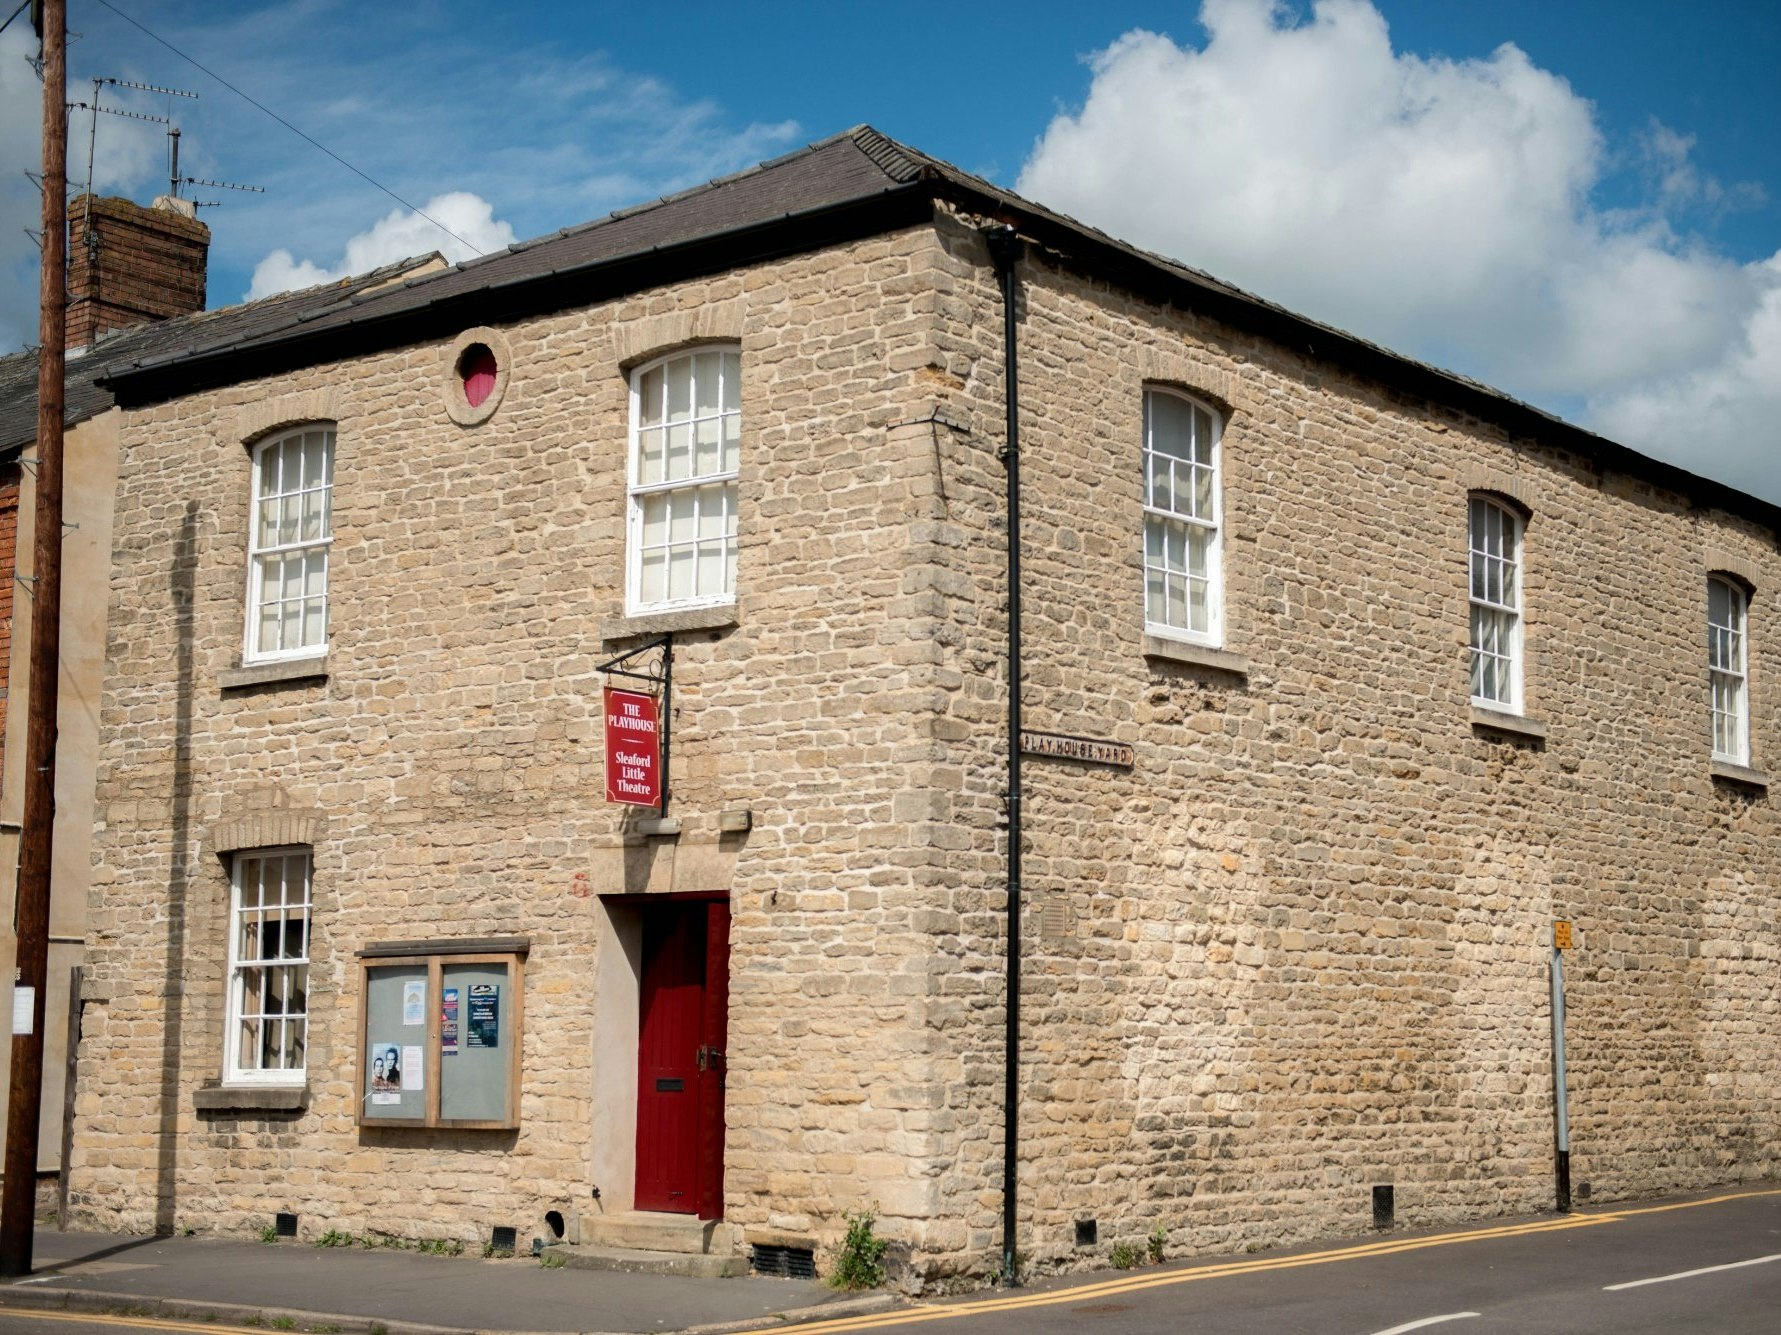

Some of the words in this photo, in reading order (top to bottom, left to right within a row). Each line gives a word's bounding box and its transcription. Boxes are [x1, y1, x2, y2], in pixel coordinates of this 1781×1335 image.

[622, 703, 641, 717] THE
[608, 714, 656, 733] PLAYHOUSE
[615, 751, 651, 768] Sleaford
[622, 766, 646, 781] Little
[616, 779, 651, 795] Theatre
